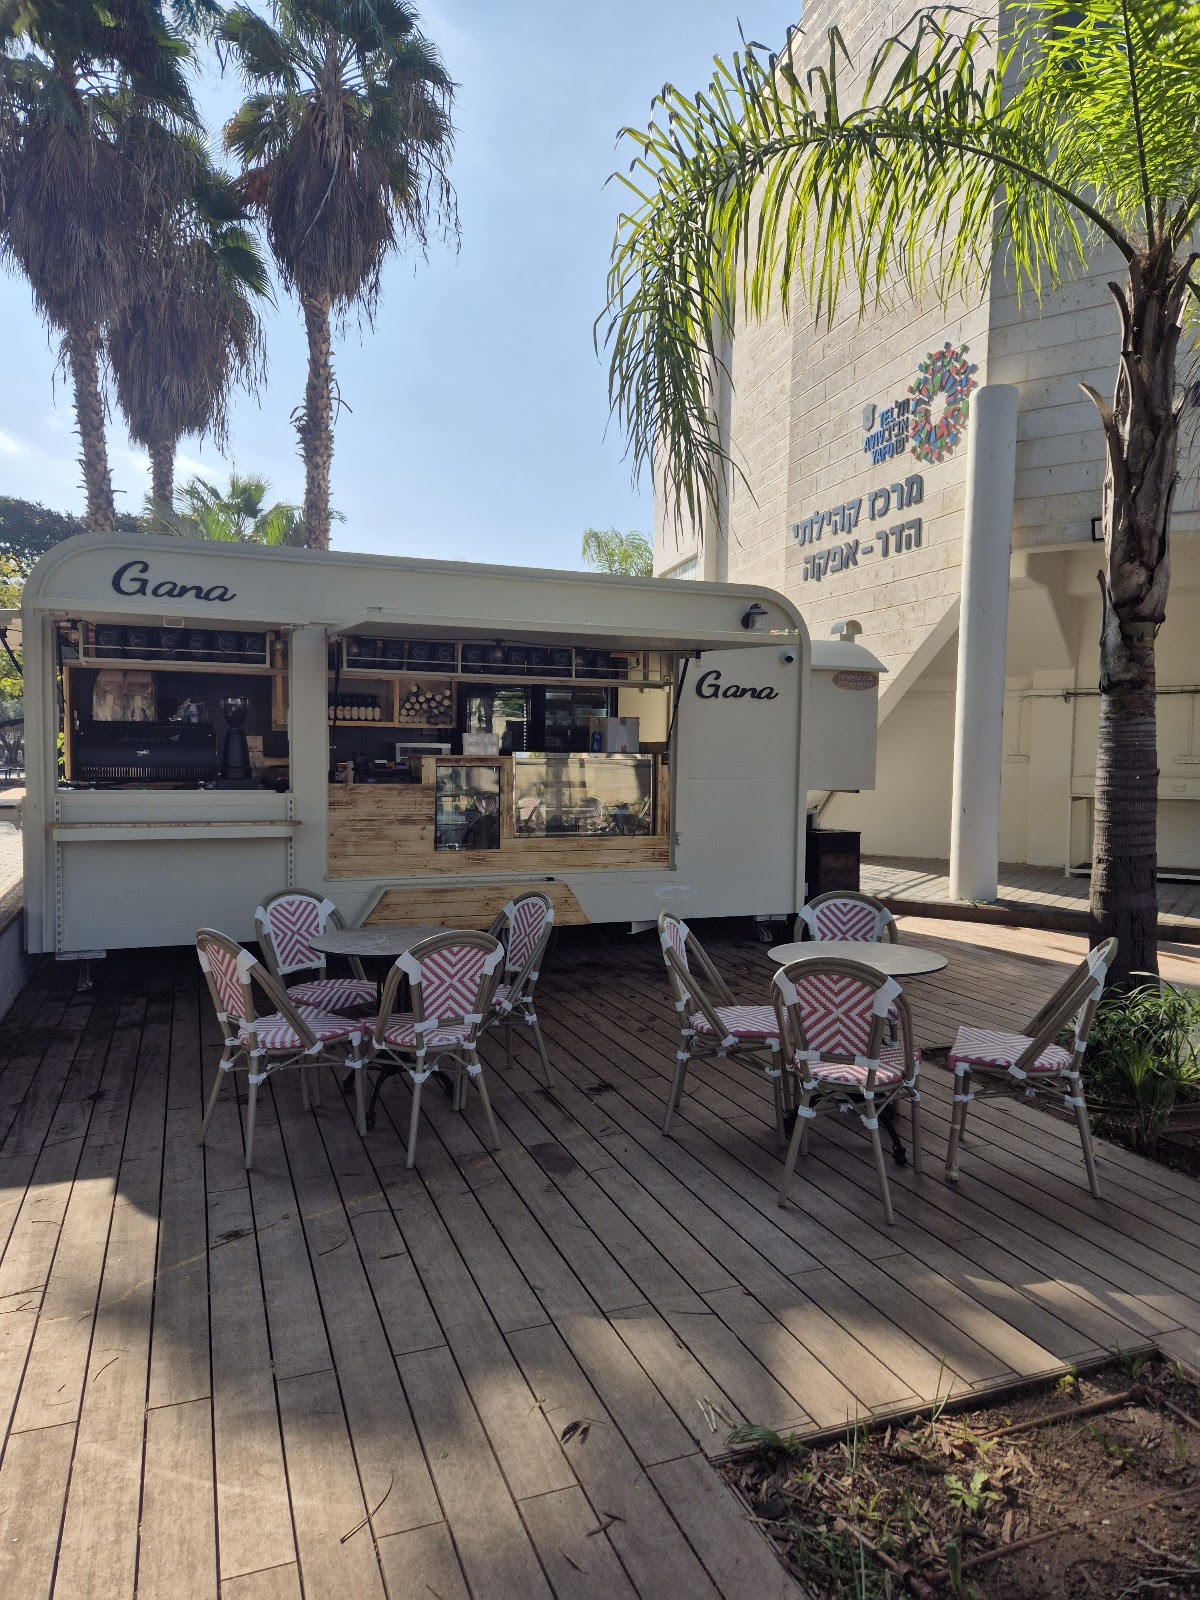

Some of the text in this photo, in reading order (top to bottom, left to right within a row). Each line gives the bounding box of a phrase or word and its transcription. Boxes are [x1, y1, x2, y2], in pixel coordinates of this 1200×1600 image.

[880, 407, 896, 428] TEL
[884, 416, 910, 442] אביב
[864, 429, 885, 453] AVIV
[871, 442, 895, 465] YAFO
[792, 473, 925, 547] מרכז קהילתי
[111, 560, 237, 602] Gana
[695, 669, 780, 700] Gana
